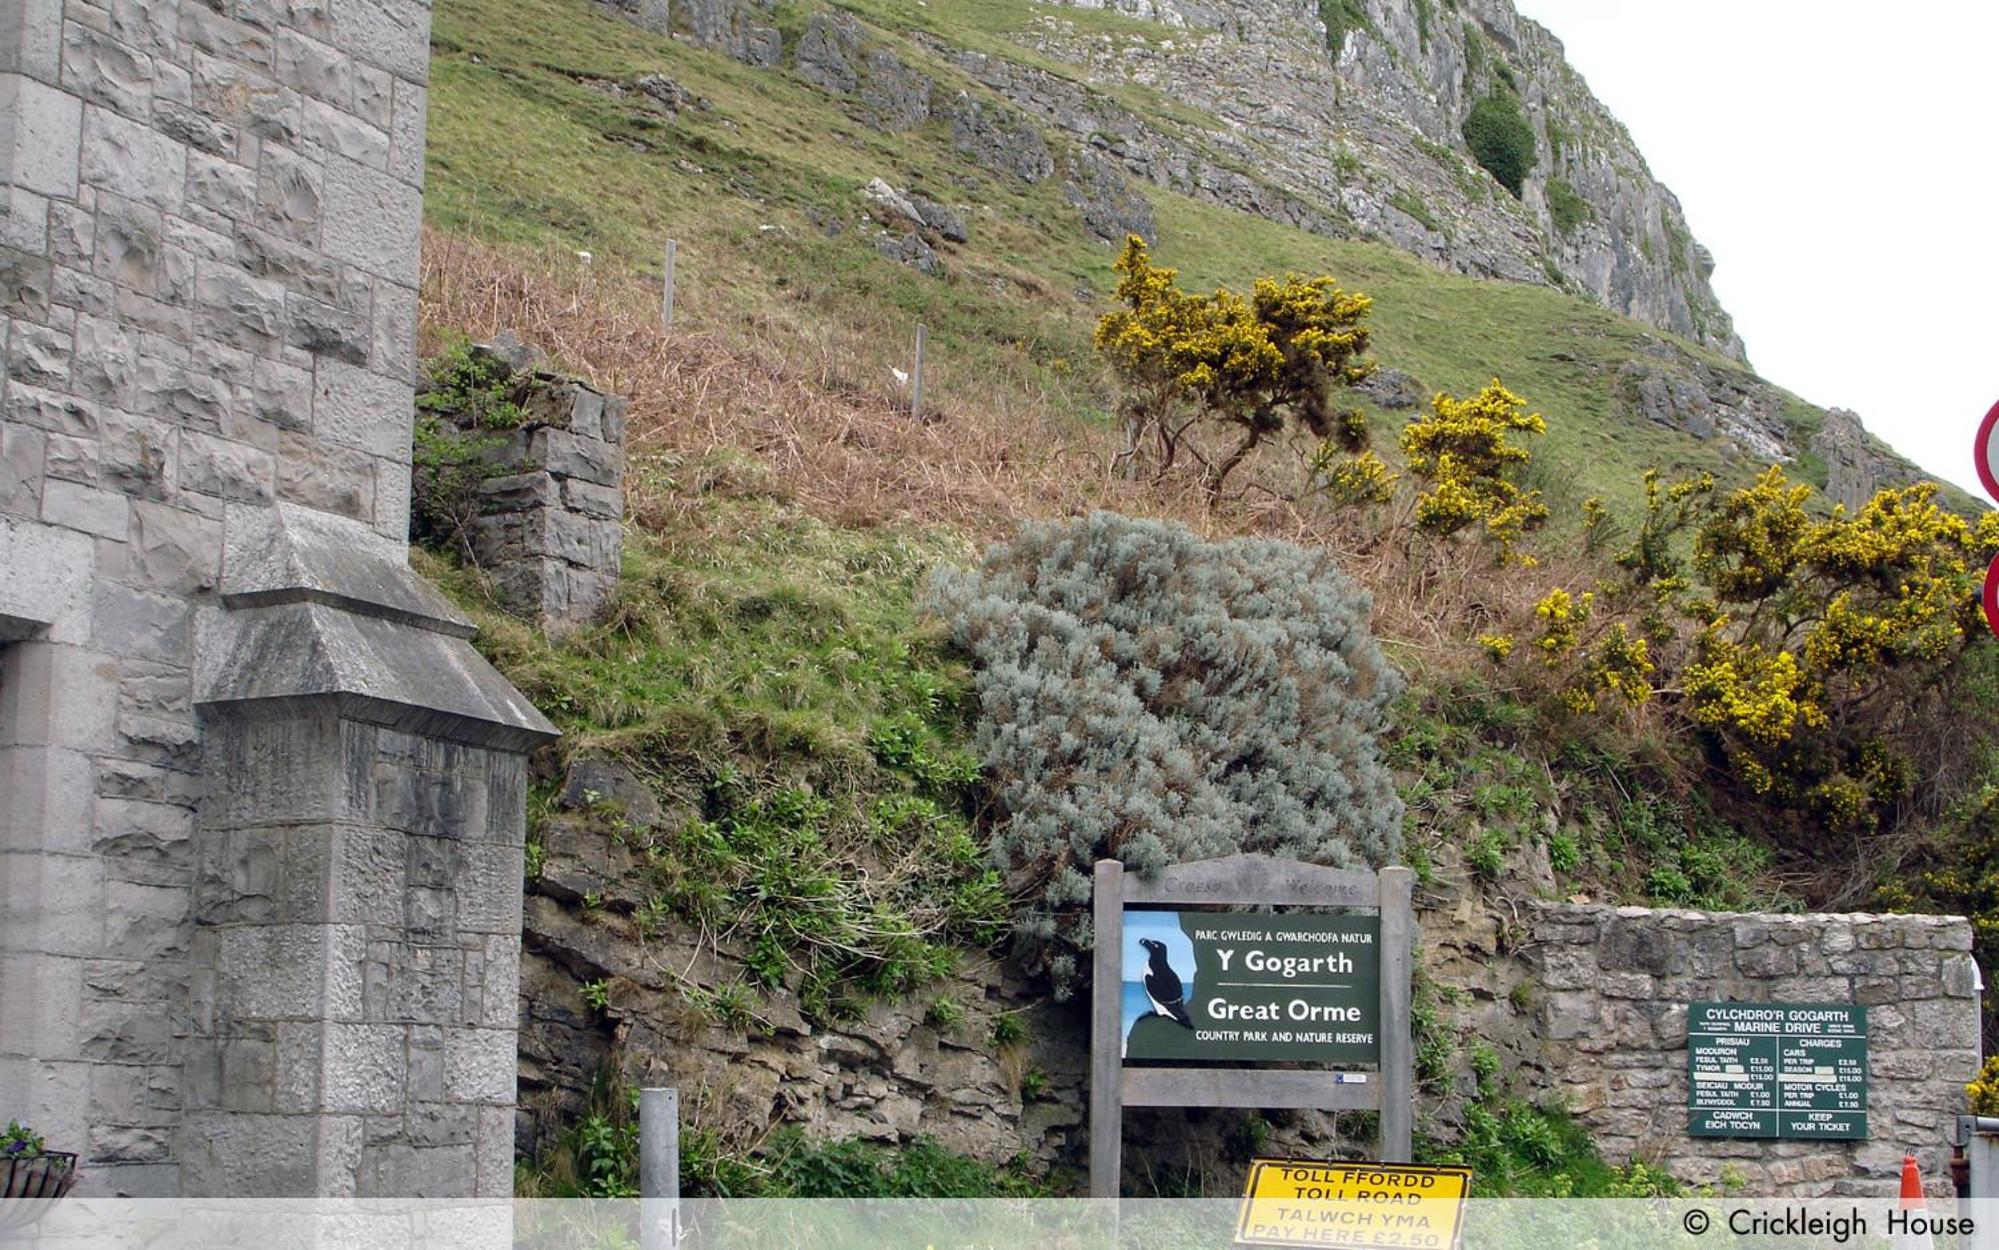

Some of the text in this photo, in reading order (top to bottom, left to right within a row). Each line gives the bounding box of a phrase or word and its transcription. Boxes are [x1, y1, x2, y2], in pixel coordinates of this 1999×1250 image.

[1195, 930, 1373, 944] PARC GWLEDIG A GWARCHODFA NATUR
[1216, 949, 1353, 977] Y Gogarth
[1207, 998, 1362, 1022] Great Orme
[1706, 1008, 1849, 1022] CYLCHDRO'R GOGARTH
[1734, 1022, 1780, 1032] MARINE
[1785, 1022, 1822, 1034] DRIVE
[1196, 1031, 1373, 1044] COUNTRY PARK AND NATURE RESERVE
[1716, 1037, 1750, 1046] PRISIAU
[1799, 1038, 1842, 1048] CHARGES
[1783, 1048, 1806, 1057] CARS
[1733, 1082, 1764, 1090] MODUR
[1783, 1083, 1847, 1092] MOTOR CYCLES
[1713, 1111, 1754, 1120] CADWCH
[1808, 1113, 1833, 1121] KEEP
[1705, 1120, 1760, 1130] EICH TOCYN
[1791, 1122, 1851, 1131] YOUR TICKET
[1281, 1168, 1436, 1189] TOLL FFORDD
[1294, 1186, 1423, 1206] TOLL ROAD
[1277, 1207, 1431, 1229] TALWCH YMA
[1252, 1223, 1440, 1248] PAY HERE £2.50
